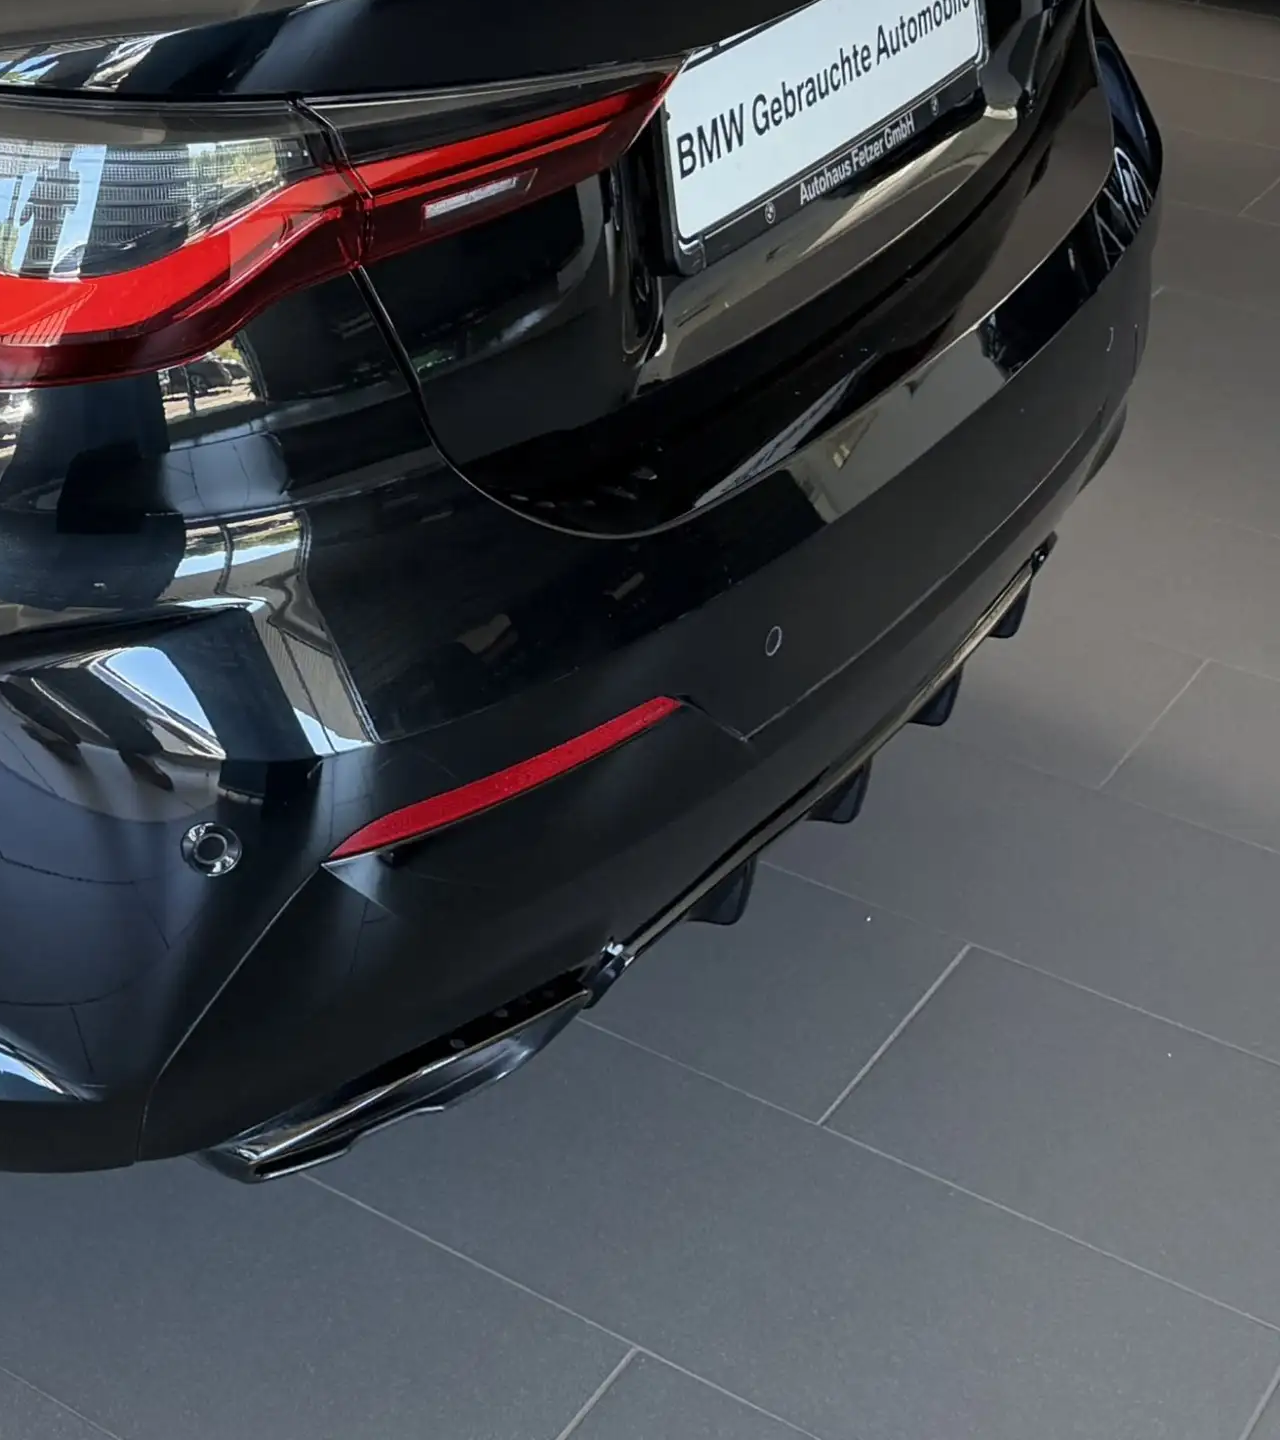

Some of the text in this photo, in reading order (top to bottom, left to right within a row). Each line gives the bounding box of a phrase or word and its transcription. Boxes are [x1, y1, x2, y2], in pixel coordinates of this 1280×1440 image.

[676, 103, 744, 180] BMW
[752, 44, 872, 137] Gebrauchte
[800, 111, 915, 205] Autohaus Fetzer GmbH
